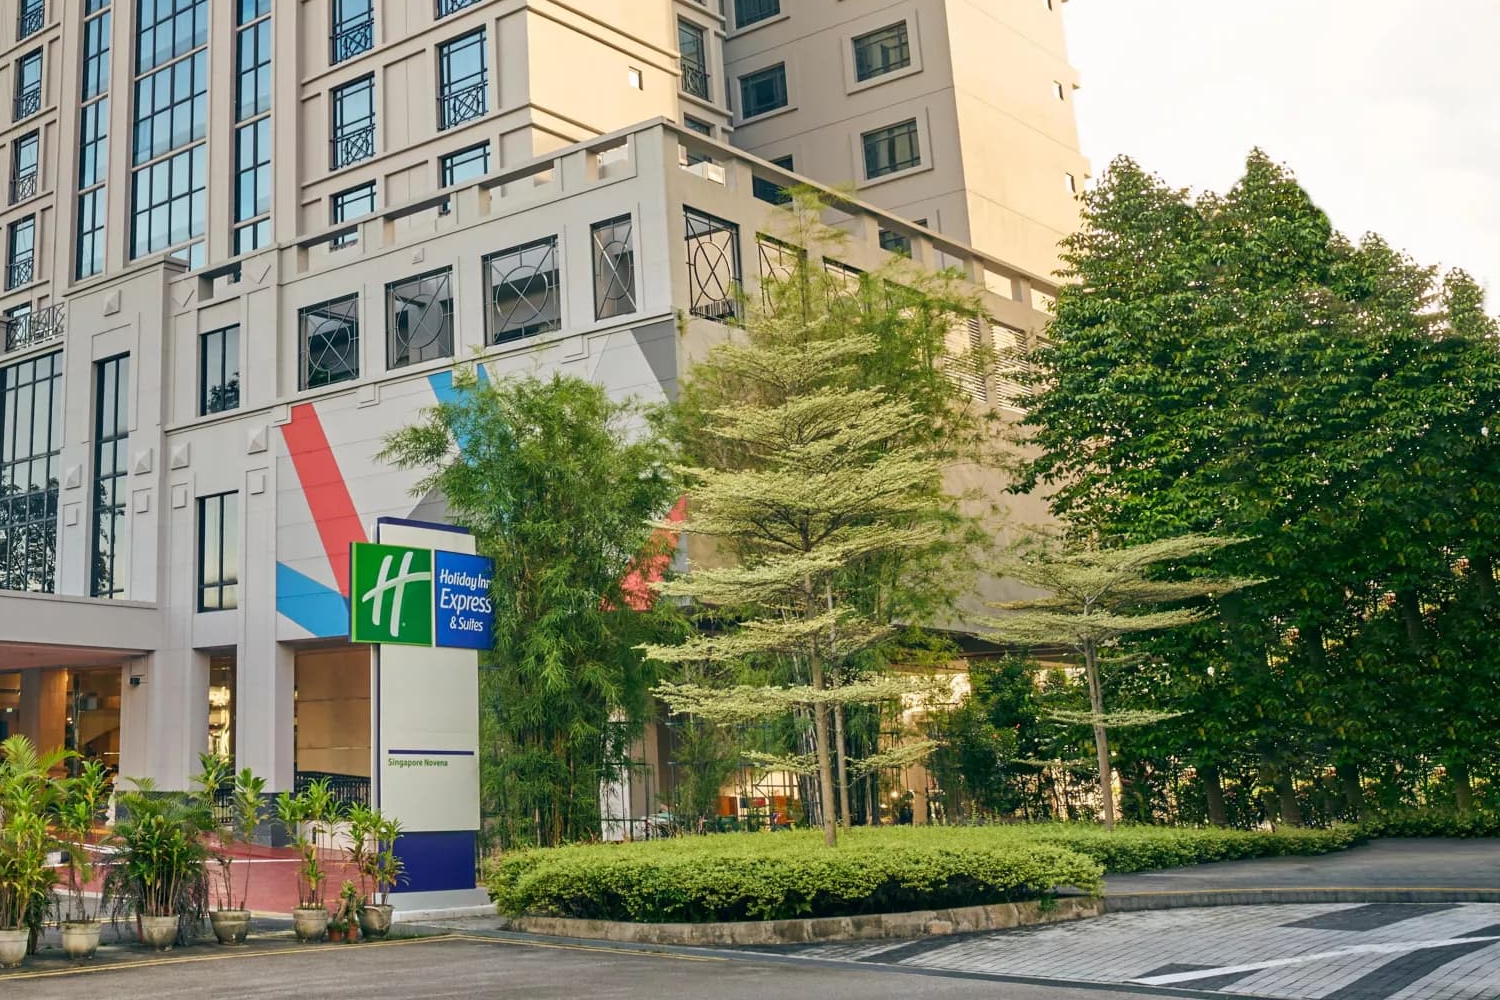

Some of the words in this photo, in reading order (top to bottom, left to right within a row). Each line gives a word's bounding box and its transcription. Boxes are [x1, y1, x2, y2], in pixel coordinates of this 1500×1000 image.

[439, 568, 477, 590] Holiday
[440, 588, 492, 615] Express
[449, 615, 457, 629] &
[458, 616, 484, 632] Suites
[388, 758, 423, 768] Singapore
[423, 759, 448, 767] Novena
